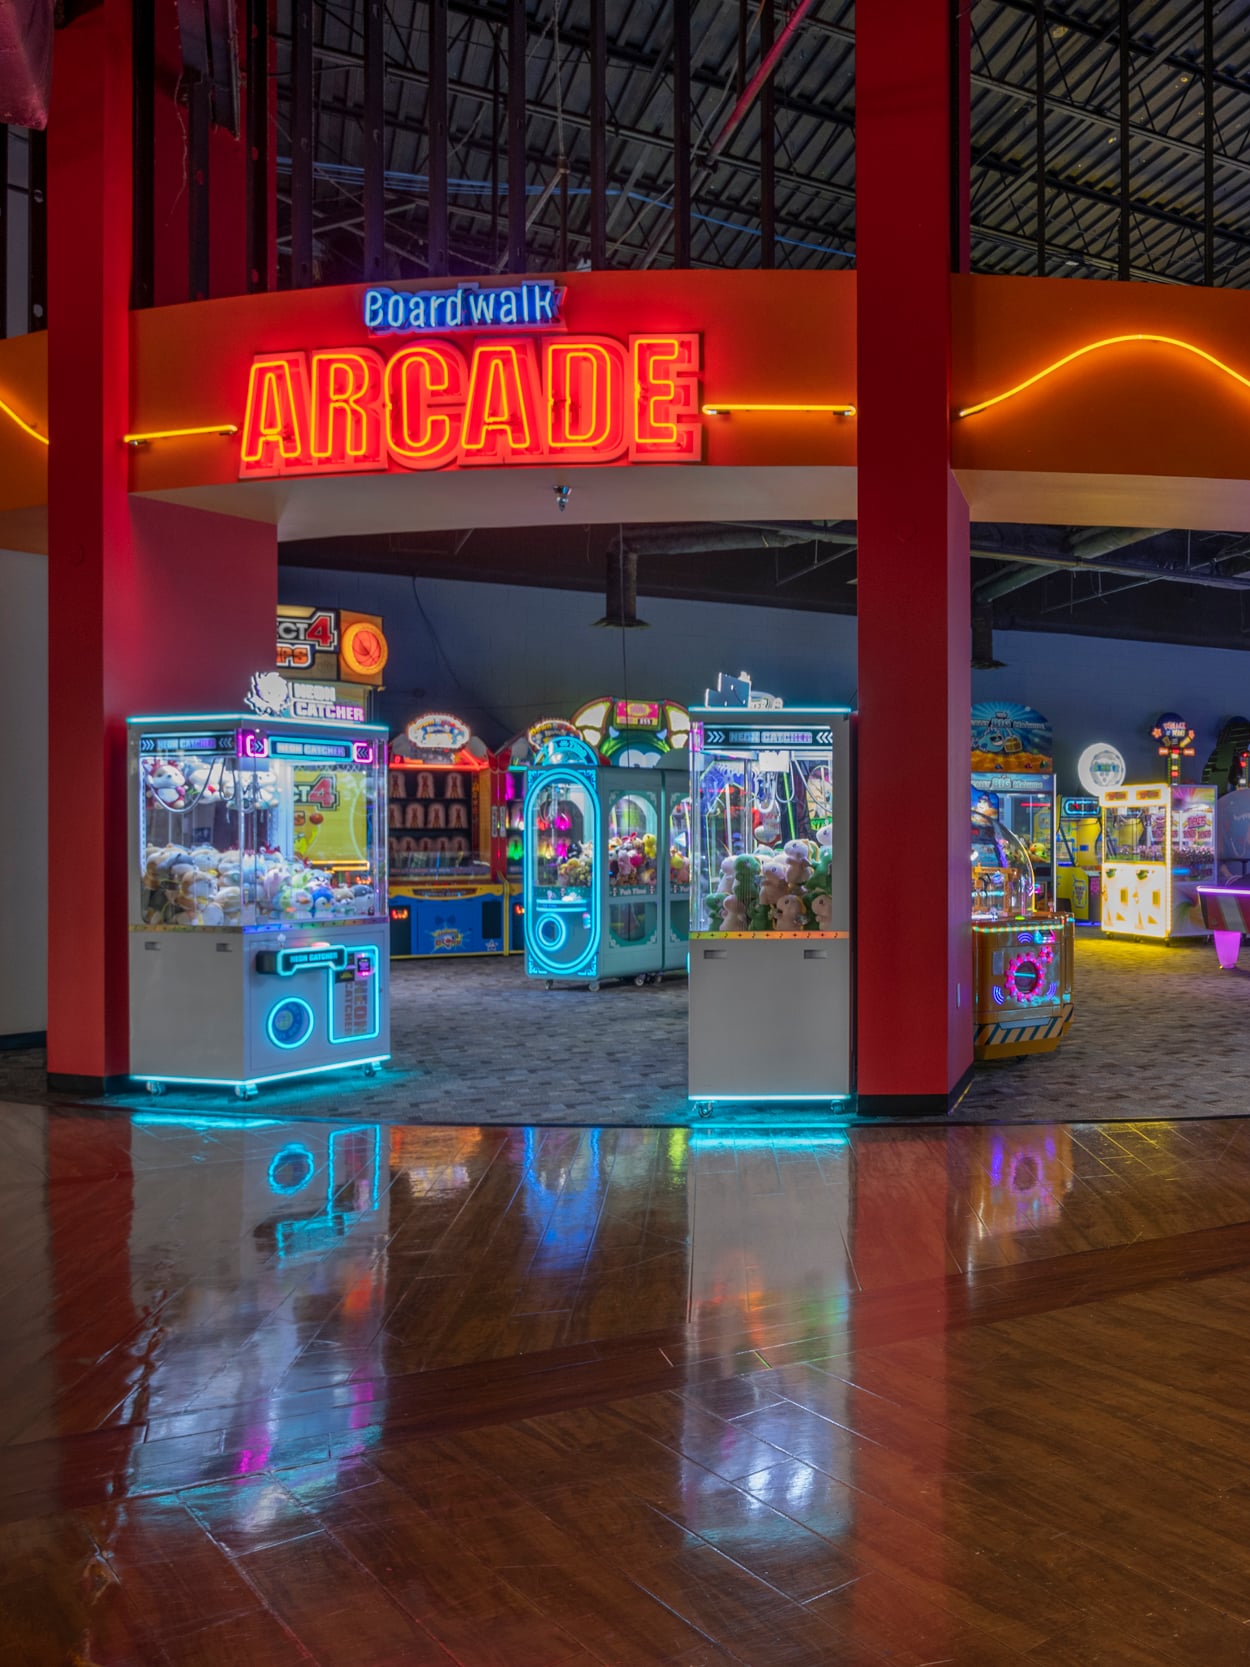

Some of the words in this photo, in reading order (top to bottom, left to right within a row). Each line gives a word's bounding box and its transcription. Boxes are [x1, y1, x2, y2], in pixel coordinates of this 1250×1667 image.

[363, 284, 555, 328] Boardwalk
[239, 333, 702, 479] ARCADE
[294, 701, 364, 721] CATCHER
